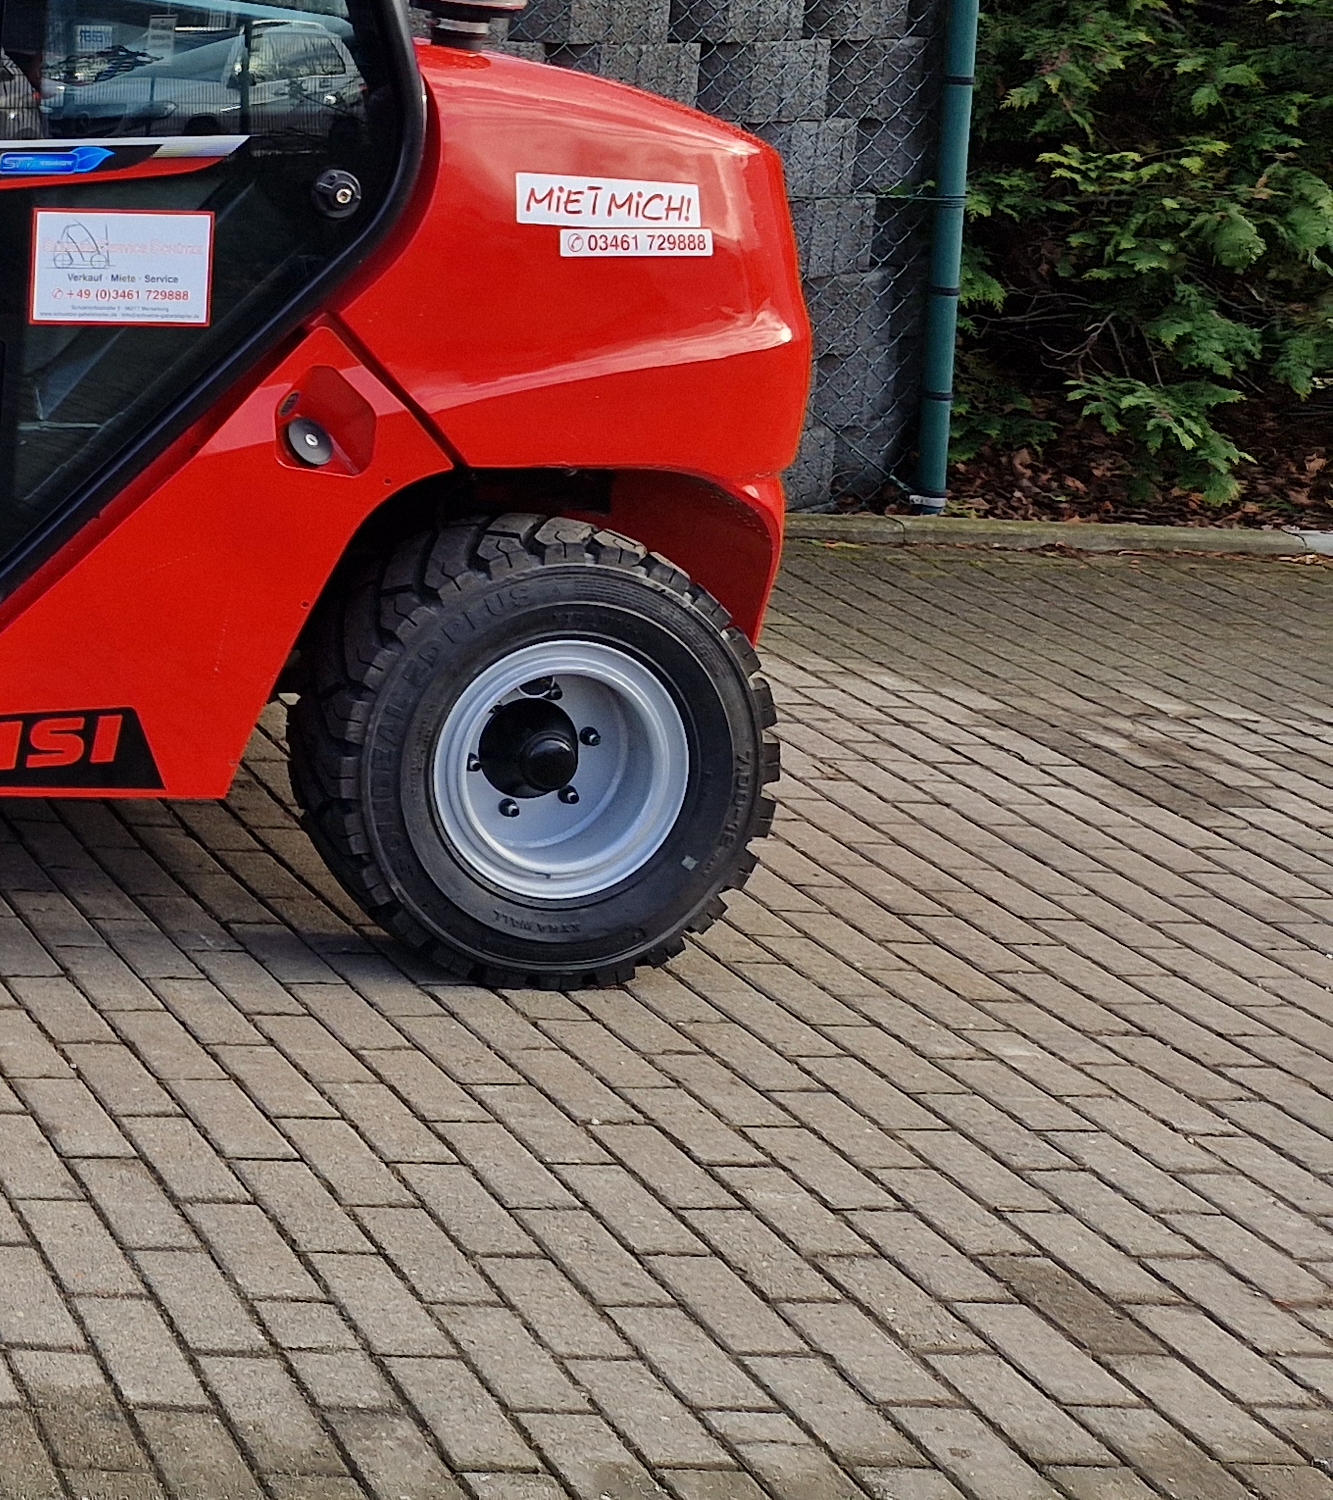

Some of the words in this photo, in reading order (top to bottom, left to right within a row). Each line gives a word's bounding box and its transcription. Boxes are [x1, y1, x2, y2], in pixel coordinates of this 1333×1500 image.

[587, 234, 640, 251] 03461
[647, 234, 707, 251] 729888
[67, 273, 103, 282] Verkauf
[110, 274, 137, 283] Miete
[144, 274, 179, 283] Service
[67, 288, 91, 299] +49
[95, 289, 140, 301] (0)3461
[145, 290, 189, 301] 729888
